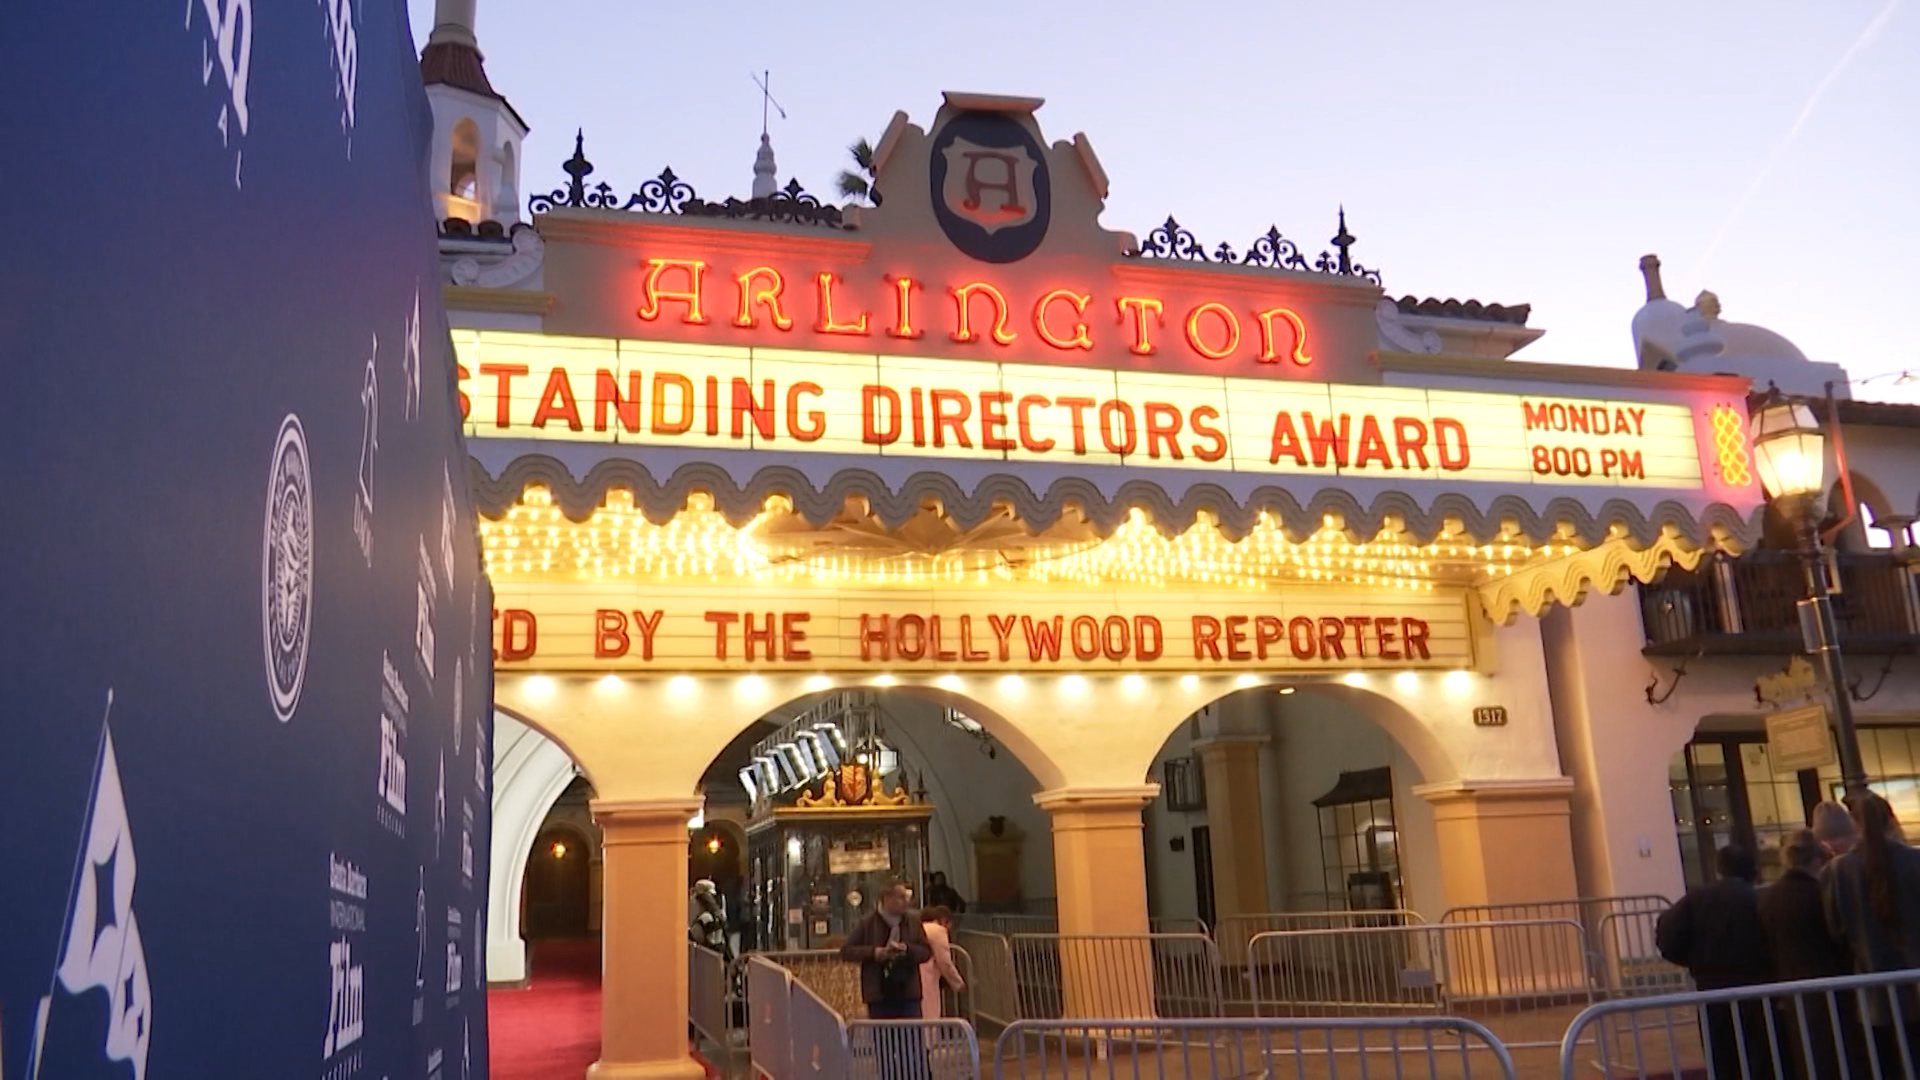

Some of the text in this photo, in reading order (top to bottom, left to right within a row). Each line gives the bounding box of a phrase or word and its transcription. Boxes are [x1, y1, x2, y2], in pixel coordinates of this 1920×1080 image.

[862, 384, 1228, 462] DIRECTORS
[1269, 411, 1471, 472] AWARD
[1522, 401, 1646, 437] MONDAY
[1531, 445, 1645, 480] 800 PM
[493, 608, 1432, 663] D BY THE HOLLYWOOD REPORTER
